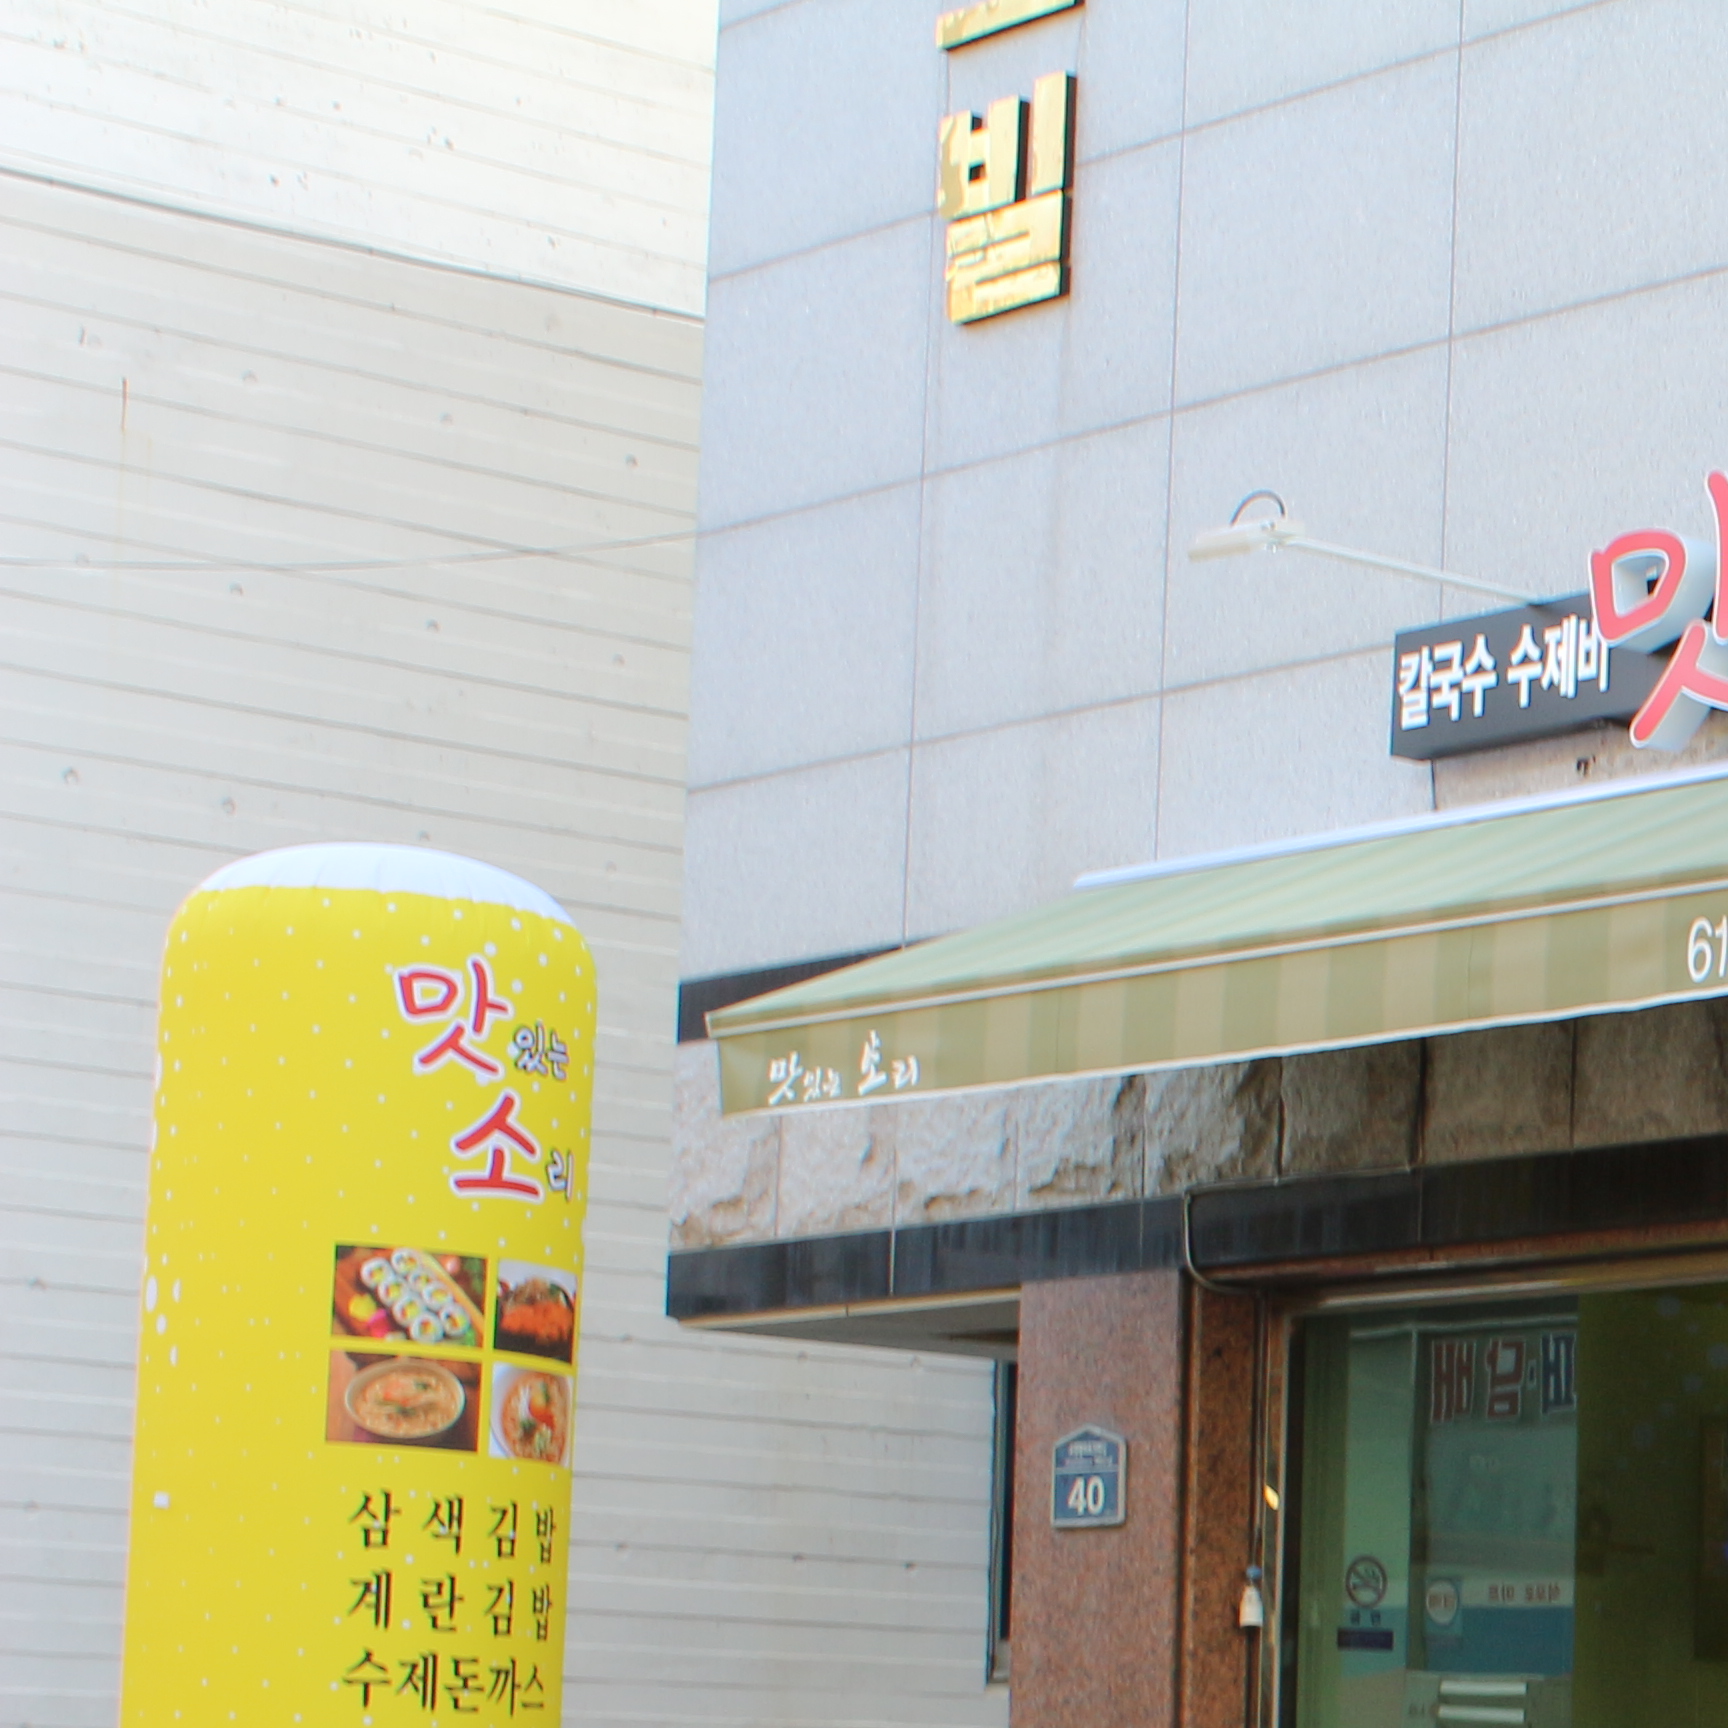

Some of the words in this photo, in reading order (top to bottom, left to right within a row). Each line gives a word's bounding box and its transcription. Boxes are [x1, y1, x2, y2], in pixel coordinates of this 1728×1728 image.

[936, 0, 1086, 325] 빌
[1398, 622, 1498, 731] 칼국수
[1507, 613, 1610, 708] 수제비
[393, 952, 572, 1082] 맛있는
[767, 1050, 842, 1106] 맛있는
[857, 1028, 921, 1097] 소리
[450, 1090, 576, 1204] 소리
[348, 1489, 557, 1565] 삼색김밥
[1067, 1474, 1106, 1517] 40
[347, 1568, 554, 1643] 계란김밥
[341, 1649, 545, 1717] 수제돈까스
